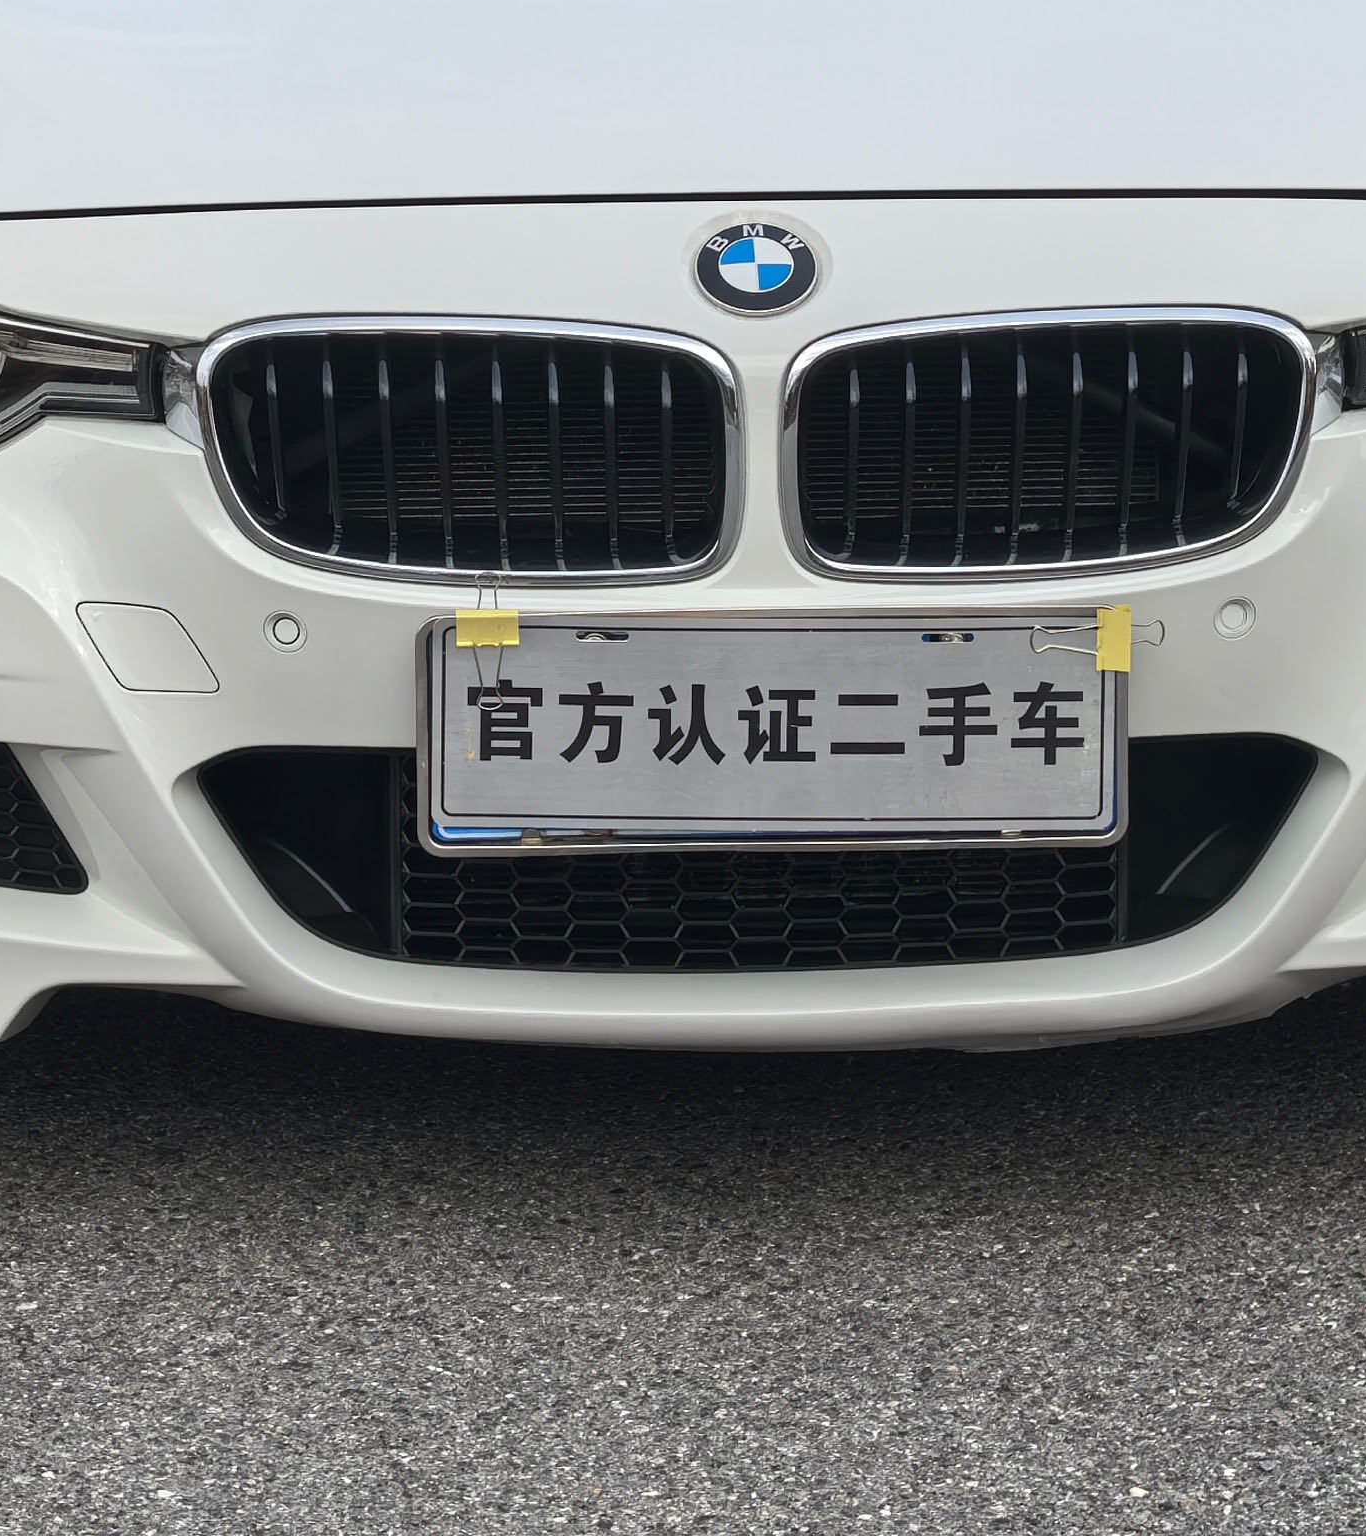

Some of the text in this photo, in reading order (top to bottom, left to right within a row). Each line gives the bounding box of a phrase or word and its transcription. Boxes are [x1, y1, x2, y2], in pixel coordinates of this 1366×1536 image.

[706, 224, 805, 252] BMW
[467, 679, 1085, 766] 官方认证二手车
